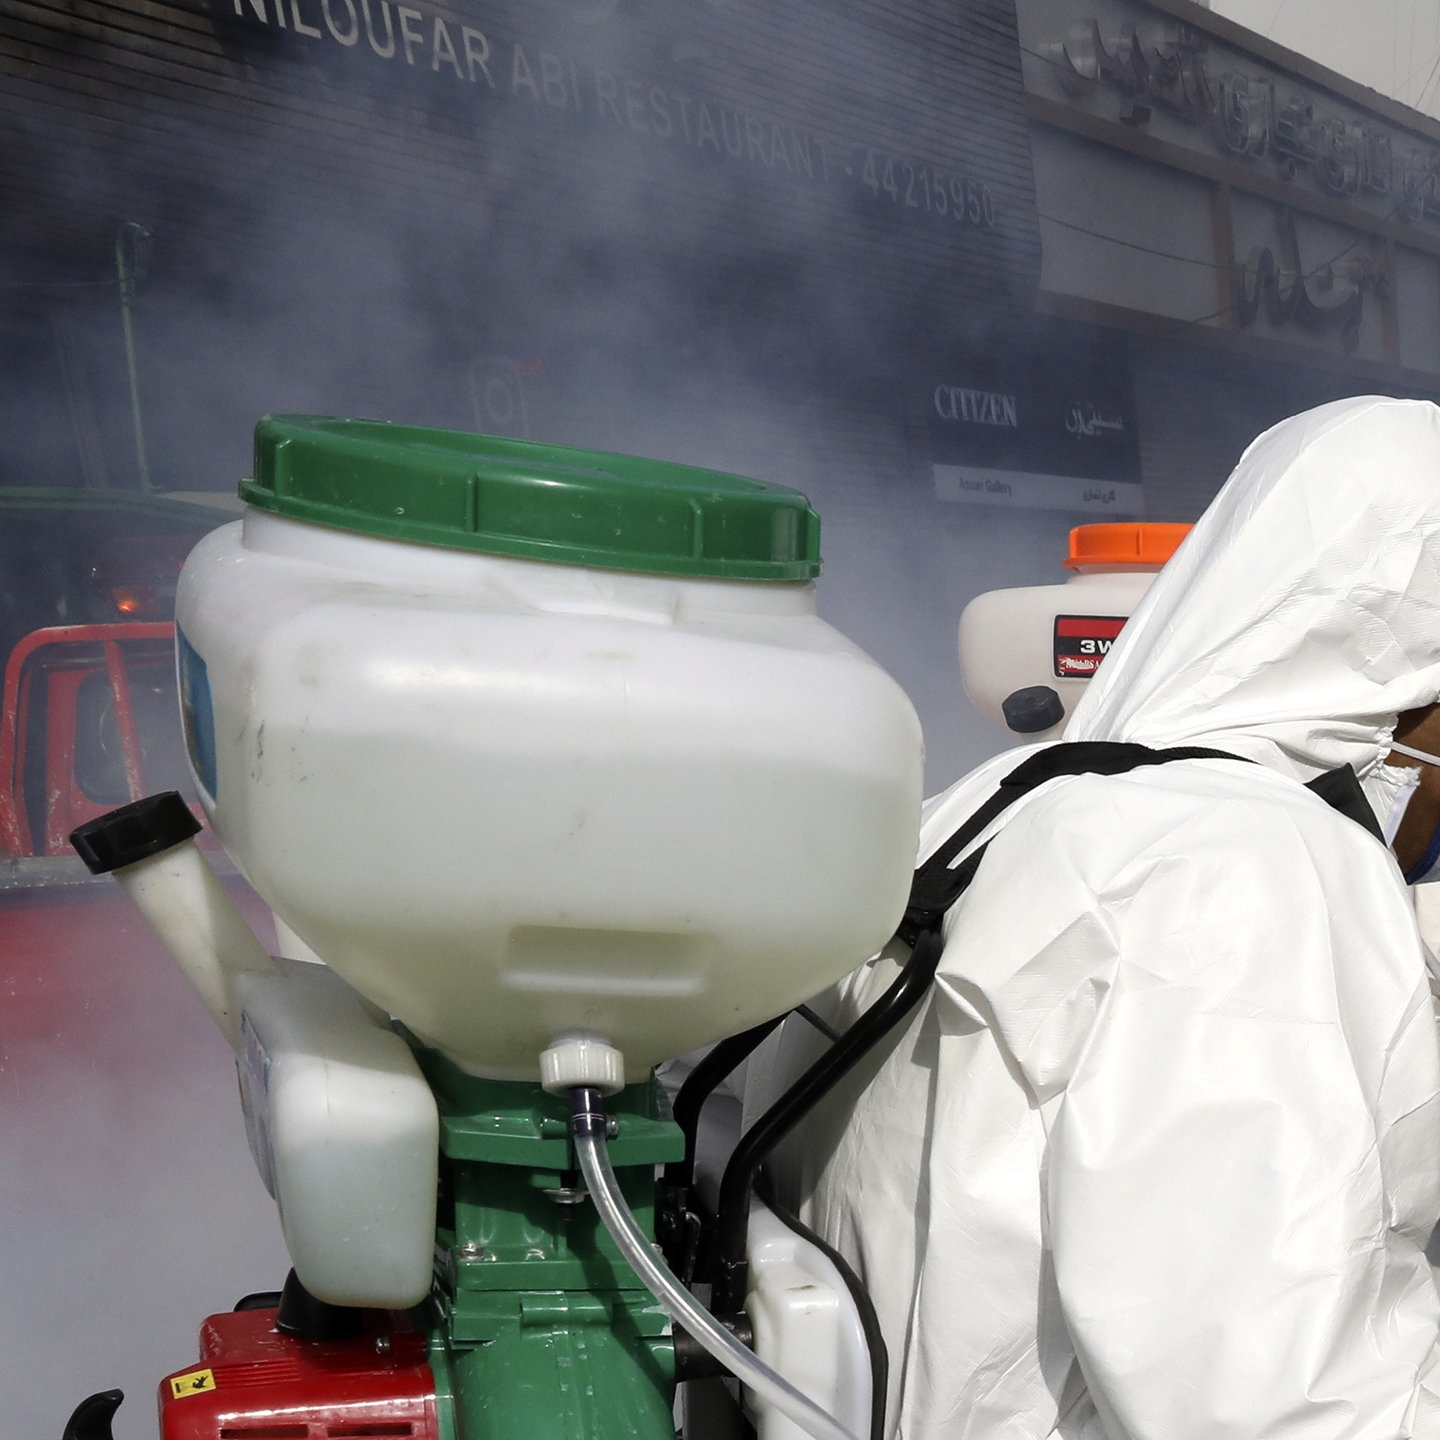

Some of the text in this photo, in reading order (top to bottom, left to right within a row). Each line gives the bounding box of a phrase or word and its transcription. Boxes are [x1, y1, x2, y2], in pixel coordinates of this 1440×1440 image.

[232, 0, 498, 89] LOUFAR
[511, 44, 581, 112] ABI
[596, 73, 830, 184] RESTAURANT
[934, 384, 1017, 428] CITIZEN
